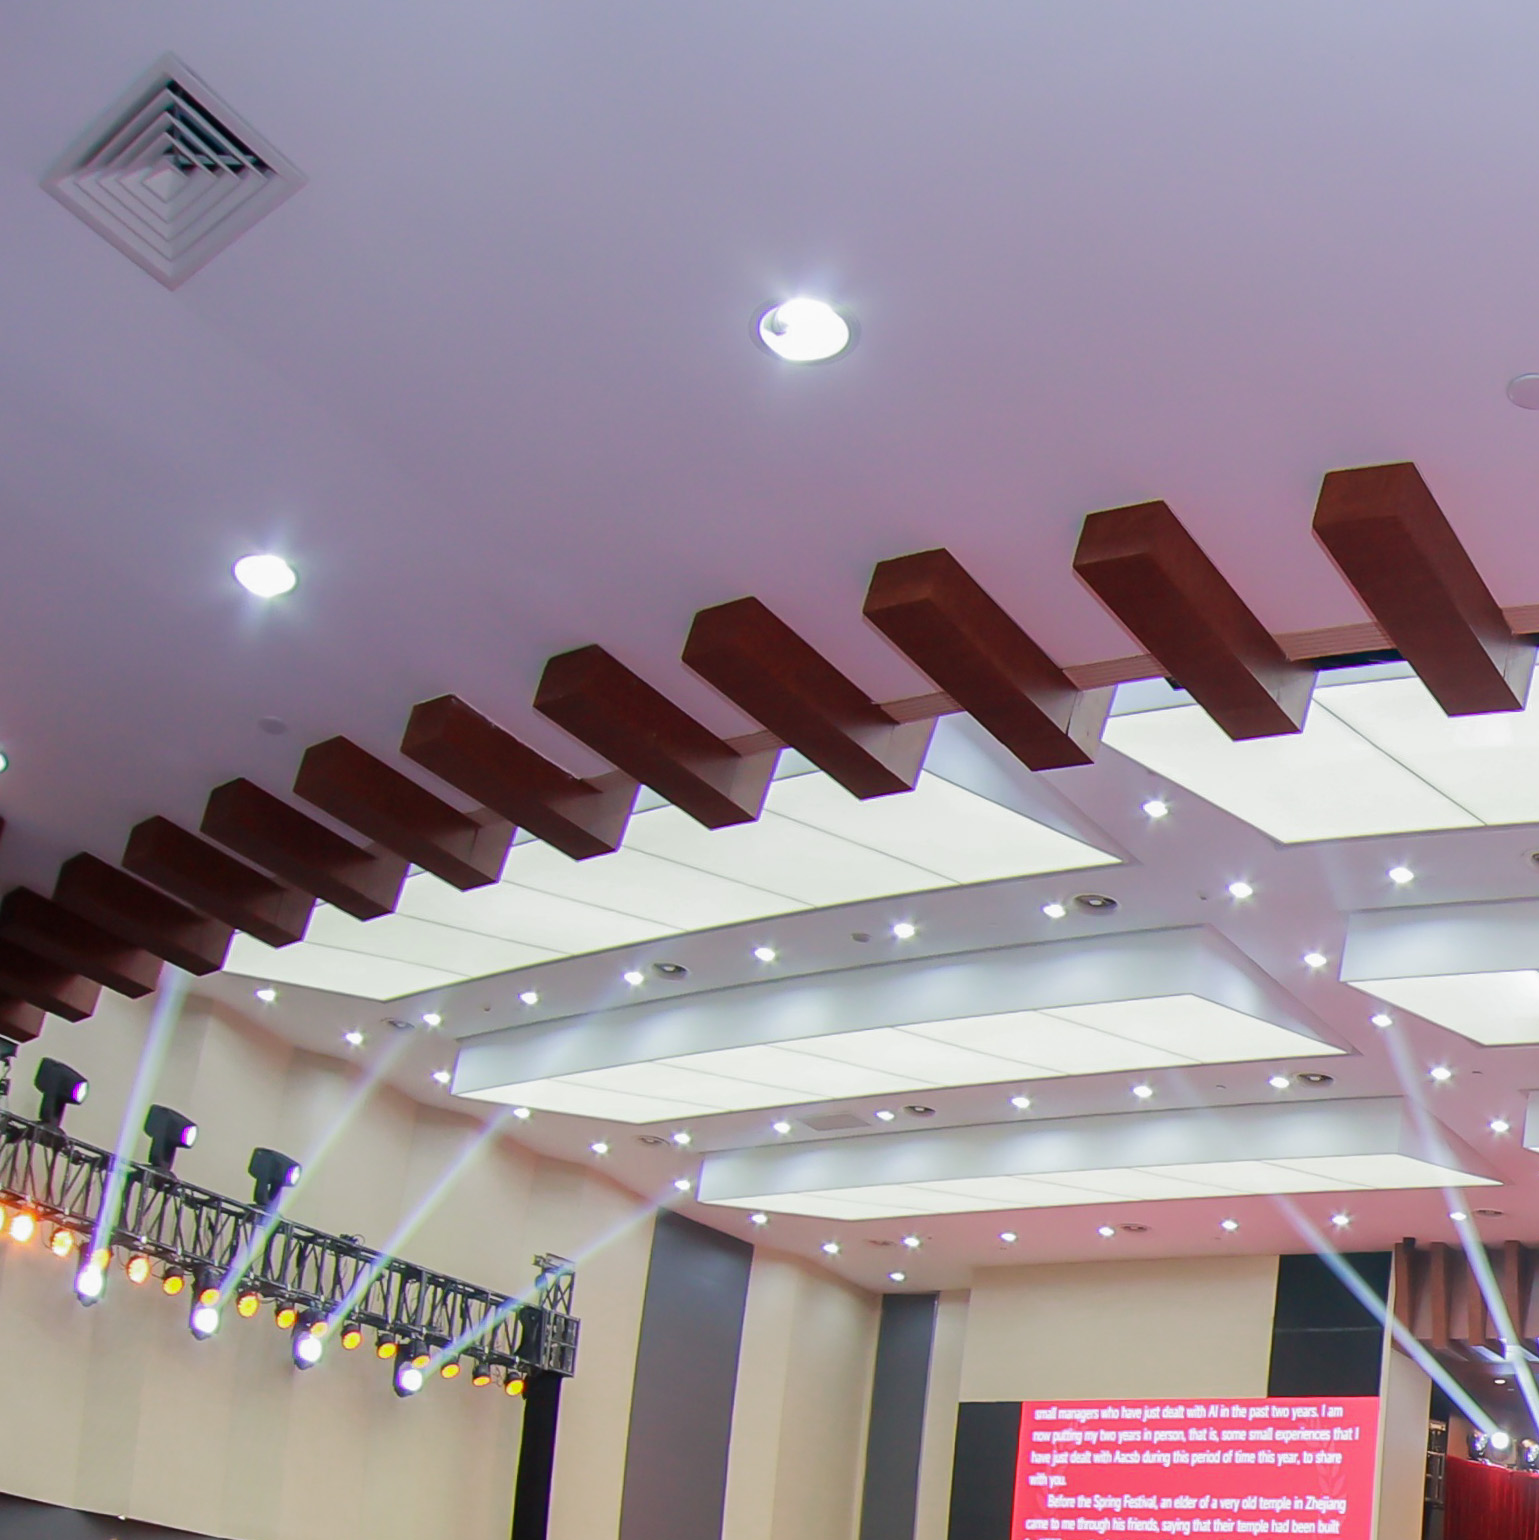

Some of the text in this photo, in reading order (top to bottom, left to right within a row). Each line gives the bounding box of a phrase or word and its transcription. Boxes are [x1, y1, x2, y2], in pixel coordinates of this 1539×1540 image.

[1058, 1408, 1099, 1423] managers
[1121, 1406, 1142, 1419] have
[1142, 1404, 1160, 1422] just
[1162, 1405, 1184, 1419] dealt
[1186, 1404, 1206, 1418] with
[1220, 1404, 1230, 1418] in
[1231, 1404, 1246, 1418] the
[1248, 1406, 1270, 1421] past
[1271, 1405, 1289, 1418] two
[1327, 1406, 1344, 1418] am
[1084, 1431, 1098, 1444] my
[1188, 1428, 1207, 1441] that
[1221, 1430, 1246, 1441] some
[1248, 1428, 1274, 1440] small
[1275, 1428, 1330, 1444] experiences
[1333, 1427, 1353, 1440] that
[1030, 1450, 1051, 1464] have
[1093, 1450, 1112, 1464] with
[1142, 1450, 1170, 1467] during
[1173, 1450, 1189, 1464] this
[1191, 1450, 1220, 1467] period
[1222, 1449, 1233, 1464] of
[1234, 1450, 1256, 1464] time
[1258, 1450, 1275, 1464] this
[1303, 1451, 1313, 1464] to
[1315, 1450, 1342, 1464] share
[1047, 1494, 1076, 1508] Before
[1076, 1495, 1092, 1508] the
[1093, 1494, 1122, 1512] Spring
[1160, 1498, 1172, 1509] an
[1174, 1495, 1198, 1510] elder
[1200, 1494, 1210, 1510] of
[1220, 1498, 1240, 1512] very
[1242, 1496, 1258, 1510] old
[1259, 1496, 1292, 1513] temple
[1293, 1496, 1303, 1510] in
[1304, 1494, 1346, 1514] Zhejiang
[1050, 1518, 1060, 1530] to
[1077, 1517, 1110, 1534] through
[1112, 1518, 1126, 1531] his
[1162, 1518, 1190, 1536] saying
[1192, 1518, 1212, 1532] that
[1213, 1518, 1235, 1532] their
[1237, 1520, 1270, 1536] temple
[1271, 1520, 1290, 1534] had
[1291, 1520, 1316, 1534] been
[1317, 1519, 1340, 1534] built
